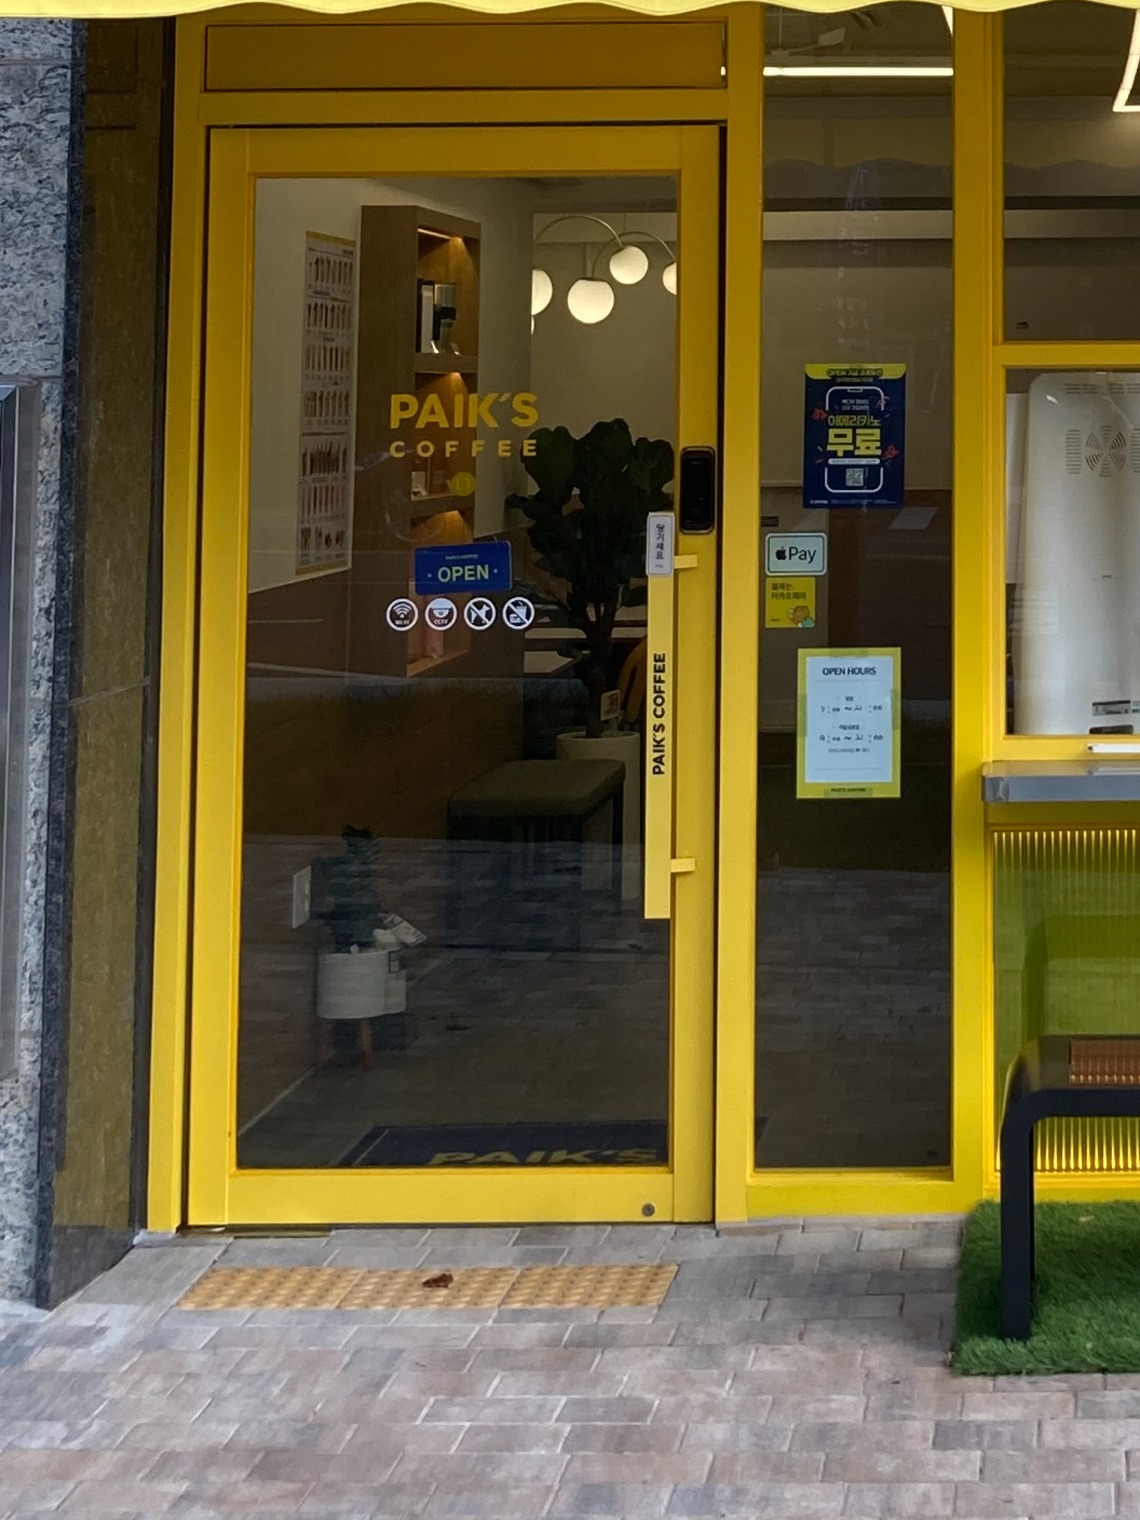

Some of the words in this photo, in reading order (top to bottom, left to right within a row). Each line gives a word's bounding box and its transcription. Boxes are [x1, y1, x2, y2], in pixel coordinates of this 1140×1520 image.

[389, 392, 540, 429] PAIK'S
[389, 439, 537, 458] COFFEE
[826, 428, 882, 457] 무료
[788, 546, 817, 564] Pay
[437, 564, 490, 583] OPEN
[822, 666, 846, 676] OPEN
[847, 666, 877, 676] HOURS
[652, 652, 666, 719] COFFEE
[652, 723, 666, 775] PAIK'S
